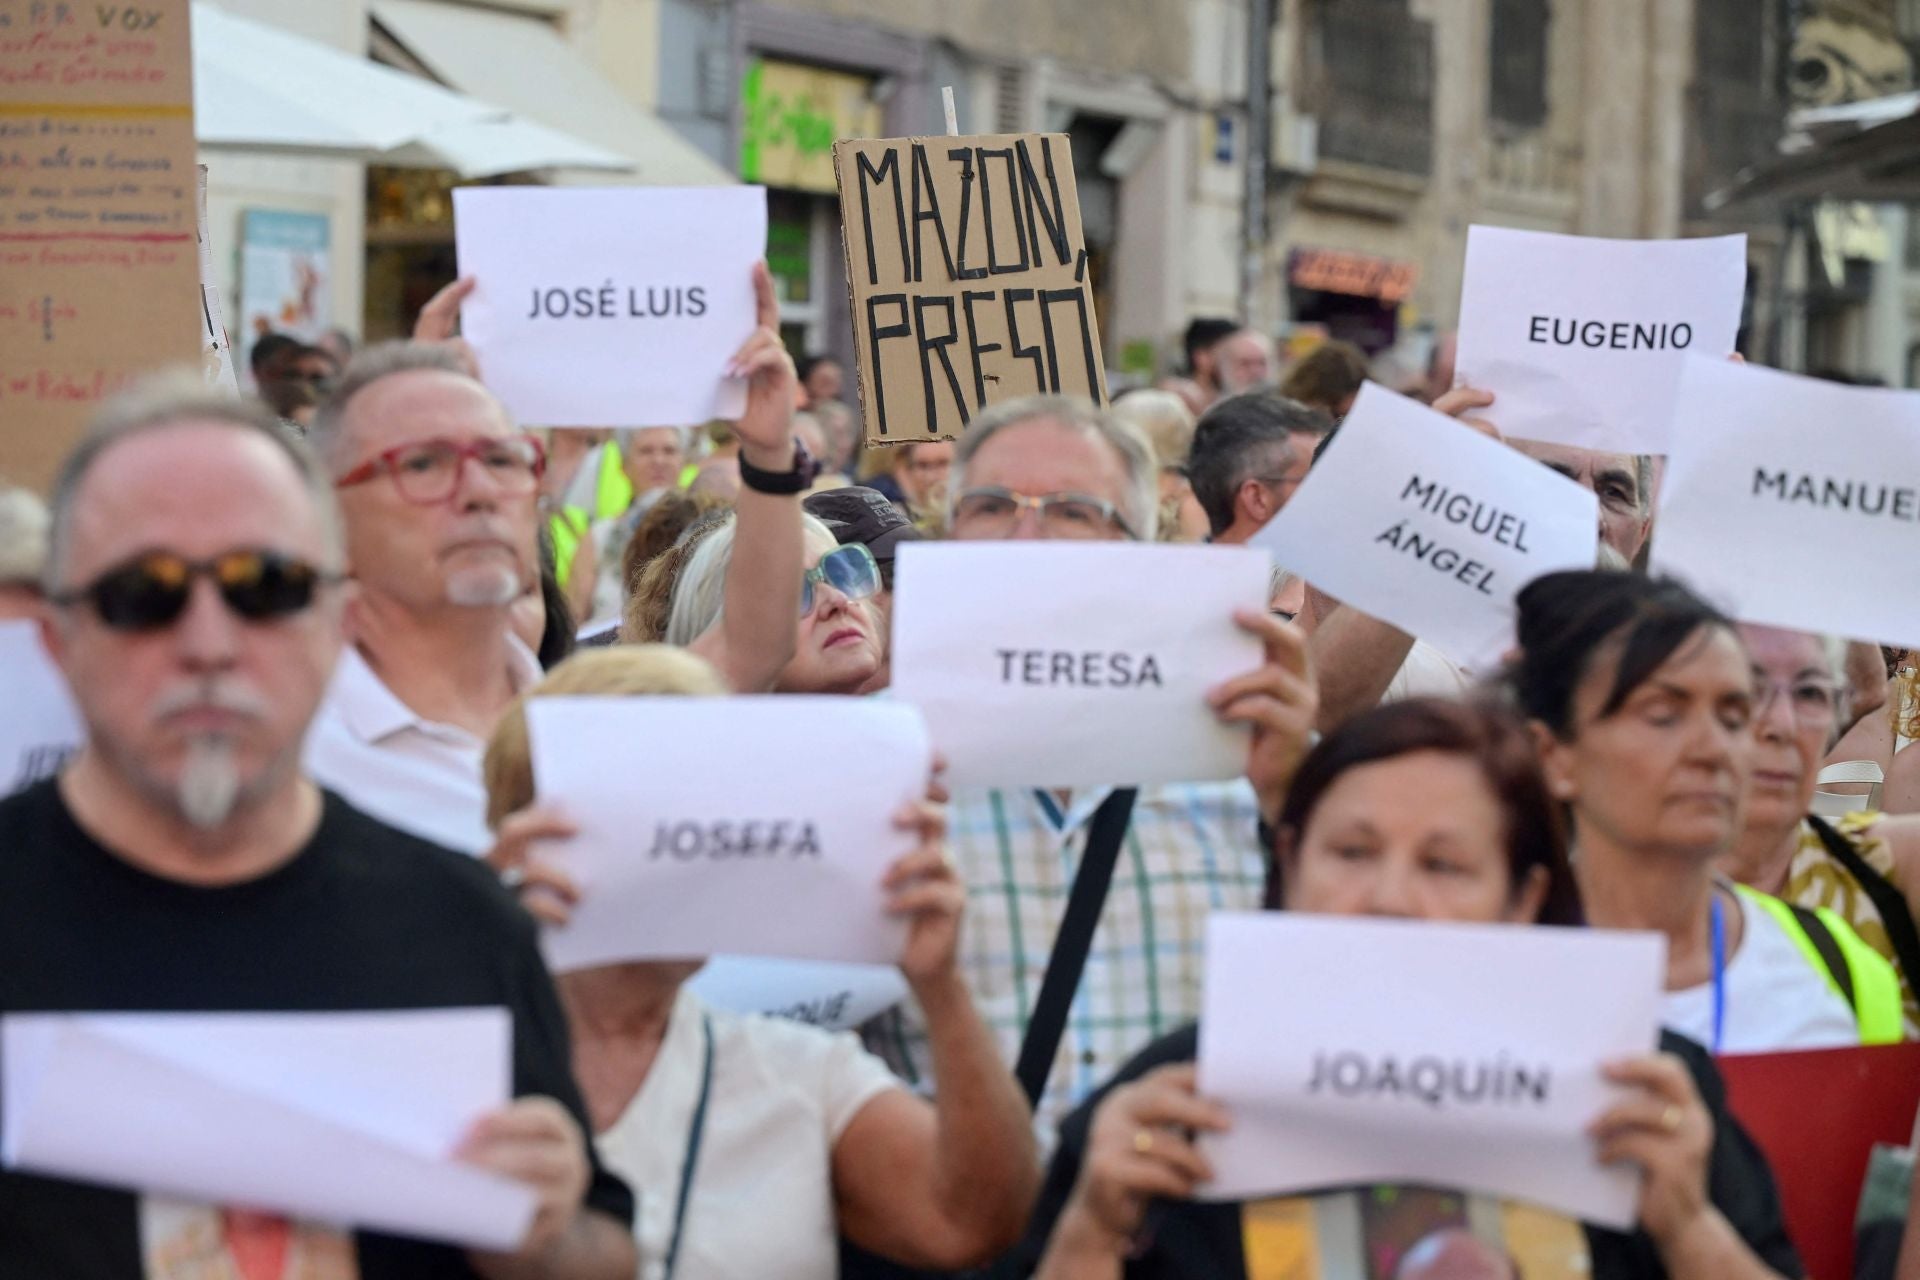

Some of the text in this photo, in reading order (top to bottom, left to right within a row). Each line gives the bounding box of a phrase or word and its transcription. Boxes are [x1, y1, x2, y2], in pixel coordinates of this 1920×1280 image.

[528, 277, 708, 320] JOSÉ LUIS
[1529, 316, 1692, 350] EUGENIO
[1400, 474, 1528, 554] MIGUEL
[1752, 466, 1920, 523] MANUE
[1374, 519, 1495, 596] ÁNGEL
[997, 649, 1164, 688] TERESA
[647, 817, 822, 863] JOSEFA
[1306, 1049, 1552, 1108] JOAQUÍN
